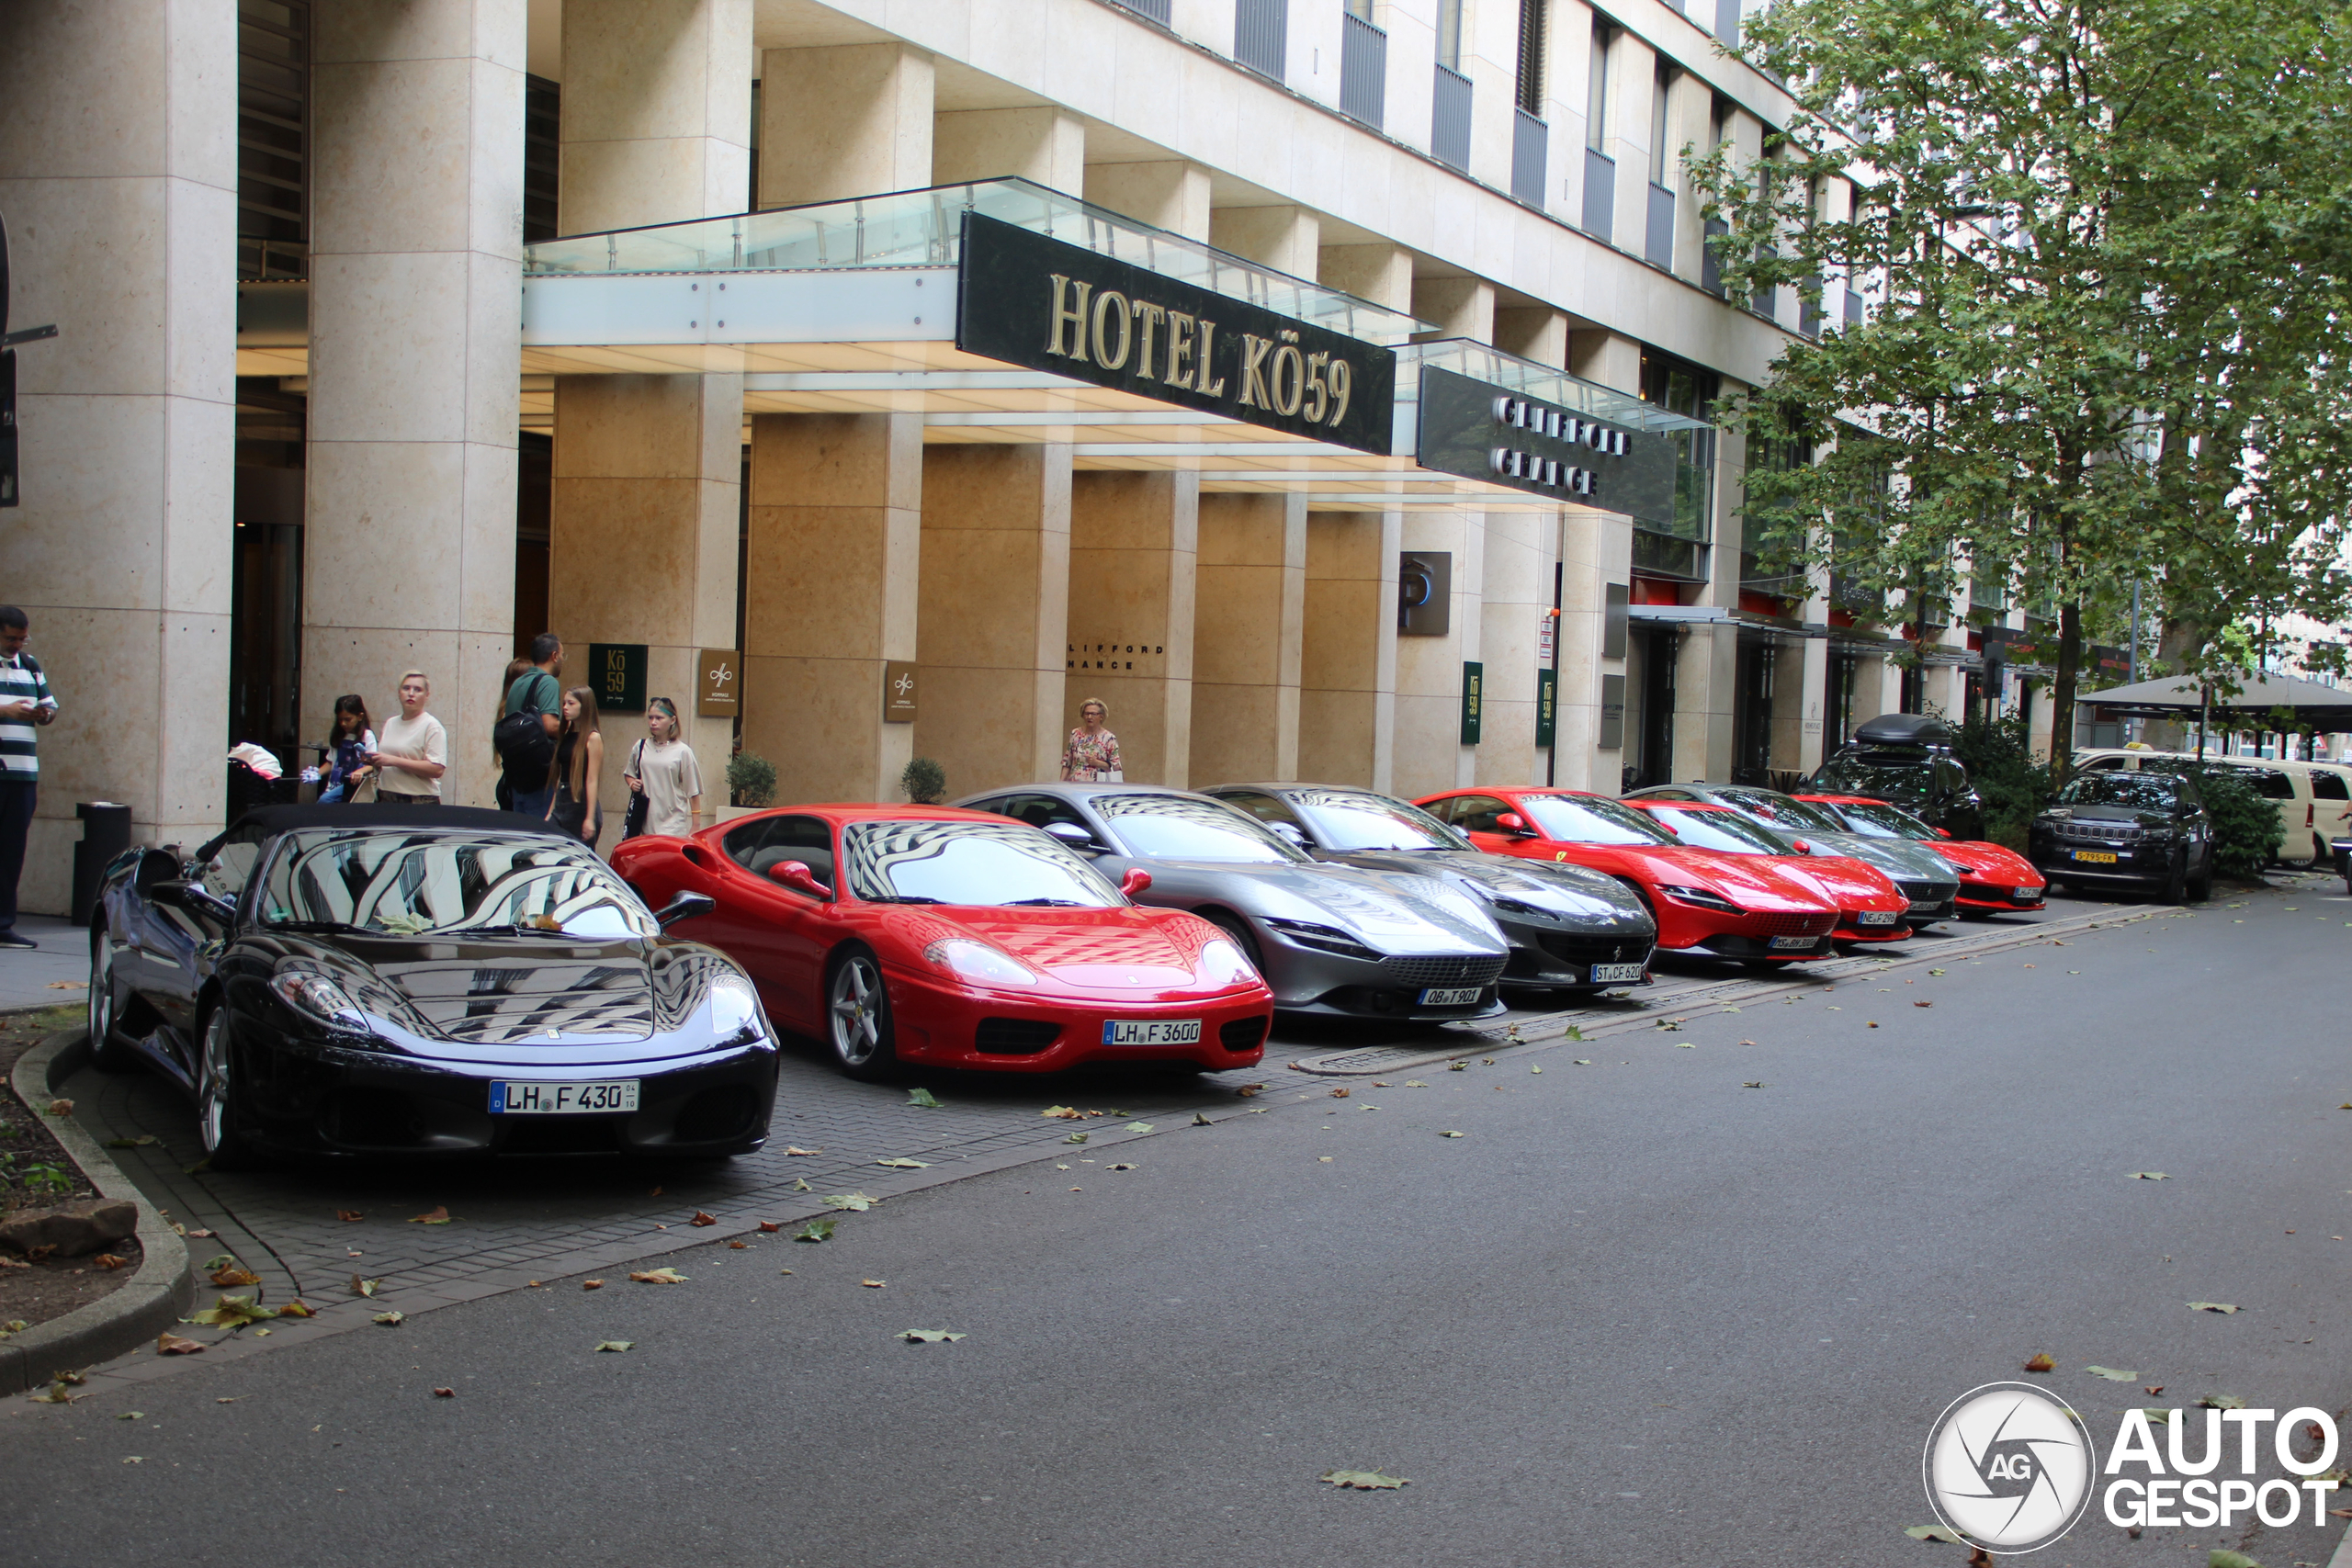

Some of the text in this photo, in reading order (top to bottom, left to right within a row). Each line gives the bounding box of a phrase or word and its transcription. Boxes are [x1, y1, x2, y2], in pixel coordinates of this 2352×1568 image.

[1046, 274, 1351, 428] HOTEL KÖ59
[1495, 397, 1632, 456] CLIFFORD
[1492, 447, 1598, 495] CHANCE
[1069, 644, 1163, 654] LIFFORD
[1068, 660, 1132, 670] HANCE
[606, 671, 625, 693] 59
[1469, 695, 1477, 716] 59
[2077, 852, 2112, 862] S-795-FK
[1863, 913, 1895, 923] NE F 296
[1774, 938, 1787, 947] MS
[1597, 965, 1640, 980] ST CF 620
[1428, 988, 1477, 1003] OB T 901
[1114, 1024, 1138, 1042] LH
[1148, 1024, 1159, 1042] F
[1162, 1022, 1199, 1041] 3600
[505, 1086, 539, 1110] LH
[556, 1086, 573, 1110] F
[578, 1085, 622, 1110] 430
